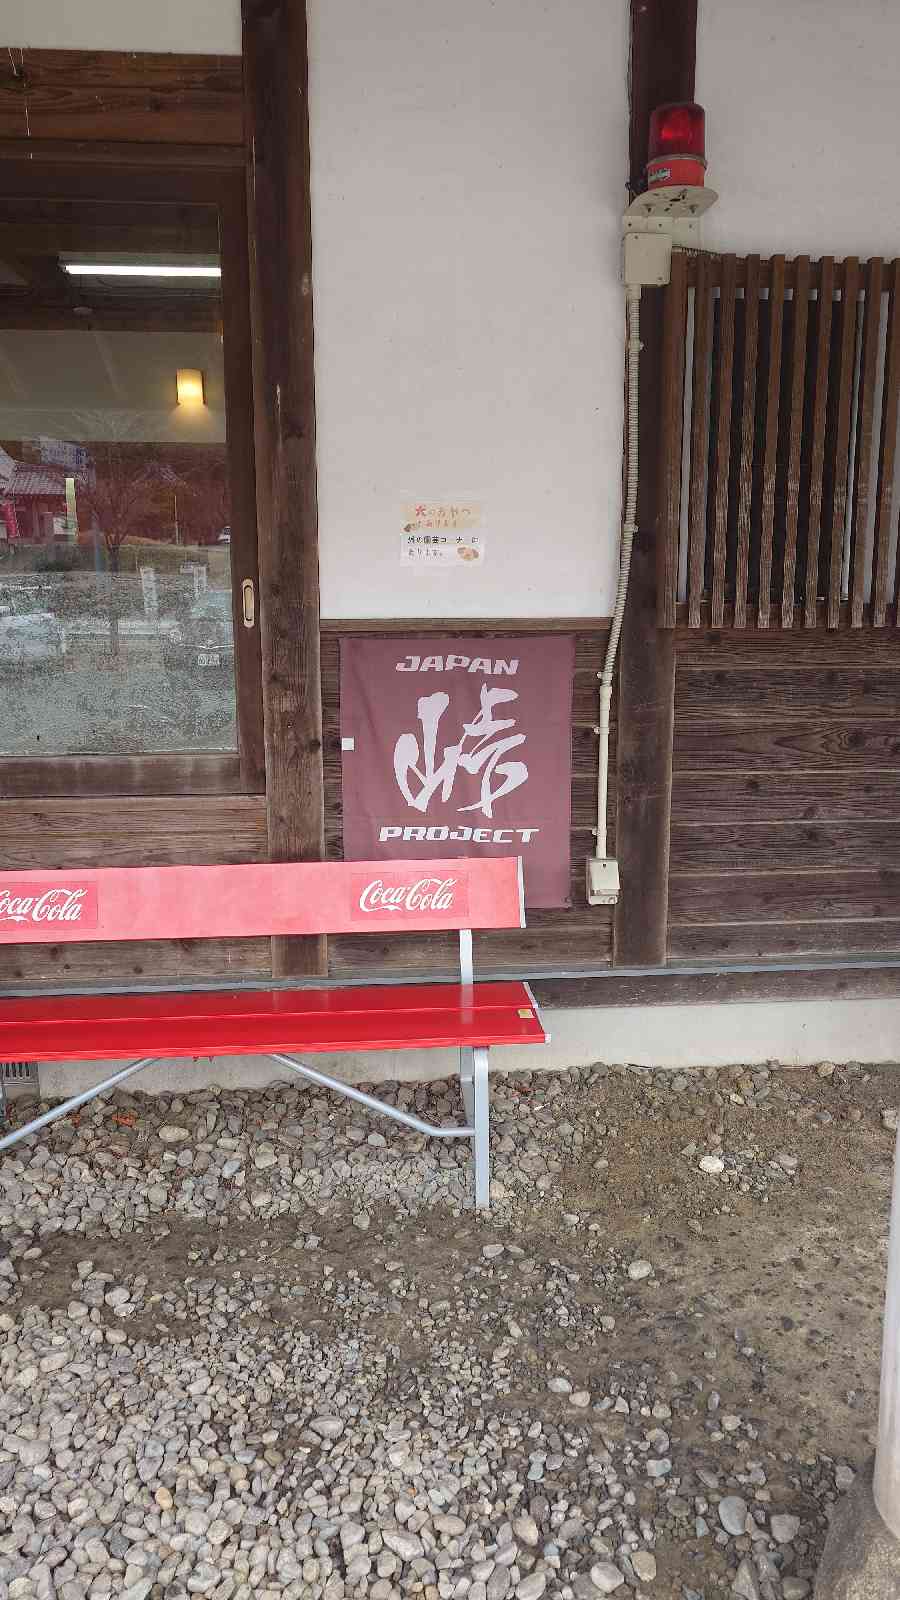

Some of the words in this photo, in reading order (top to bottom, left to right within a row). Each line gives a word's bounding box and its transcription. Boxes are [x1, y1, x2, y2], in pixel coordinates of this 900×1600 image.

[407, 535, 480, 545] 外の園芸コナに
[395, 654, 520, 676] JAPAN
[393, 682, 529, 819] 峠
[378, 825, 540, 844] PROJECT
